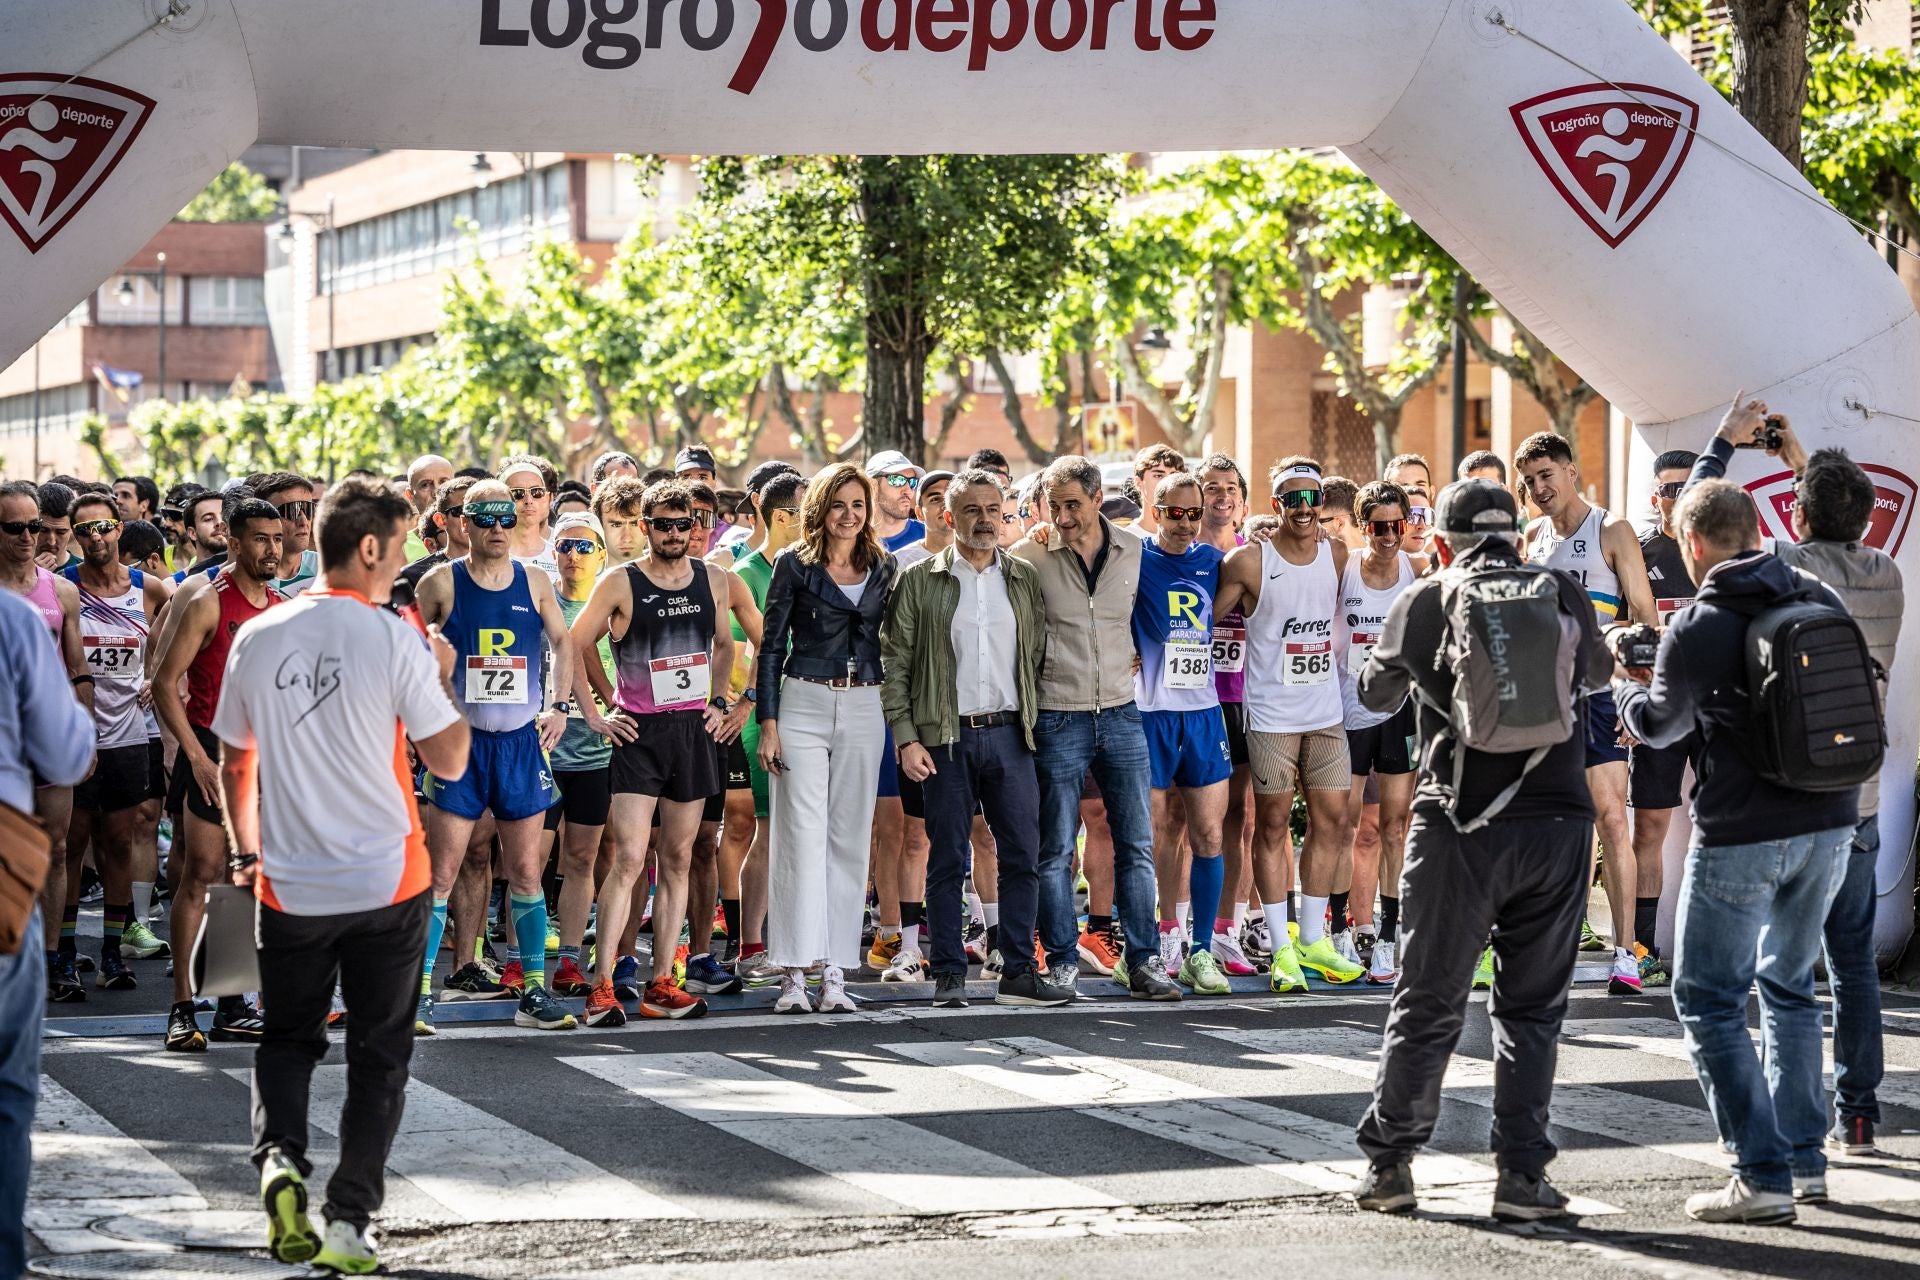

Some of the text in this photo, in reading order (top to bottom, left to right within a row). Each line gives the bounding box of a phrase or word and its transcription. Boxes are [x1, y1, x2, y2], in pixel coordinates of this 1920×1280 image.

[61, 107, 114, 129] deporte
[1550, 111, 1674, 133] Logroño deporte
[484, 503, 510, 512] NIKE
[1873, 497, 1898, 512] porte
[657, 605, 701, 617] O BARCO
[1167, 591, 1207, 631] R
[1169, 620, 1188, 628] CLUB
[1281, 617, 1331, 638] Ferrer
[479, 628, 516, 656] R
[87, 648, 135, 667] 437
[1169, 657, 1209, 676] 1383
[1291, 653, 1331, 675] 565
[481, 669, 515, 691] 72
[675, 669, 691, 690] 3
